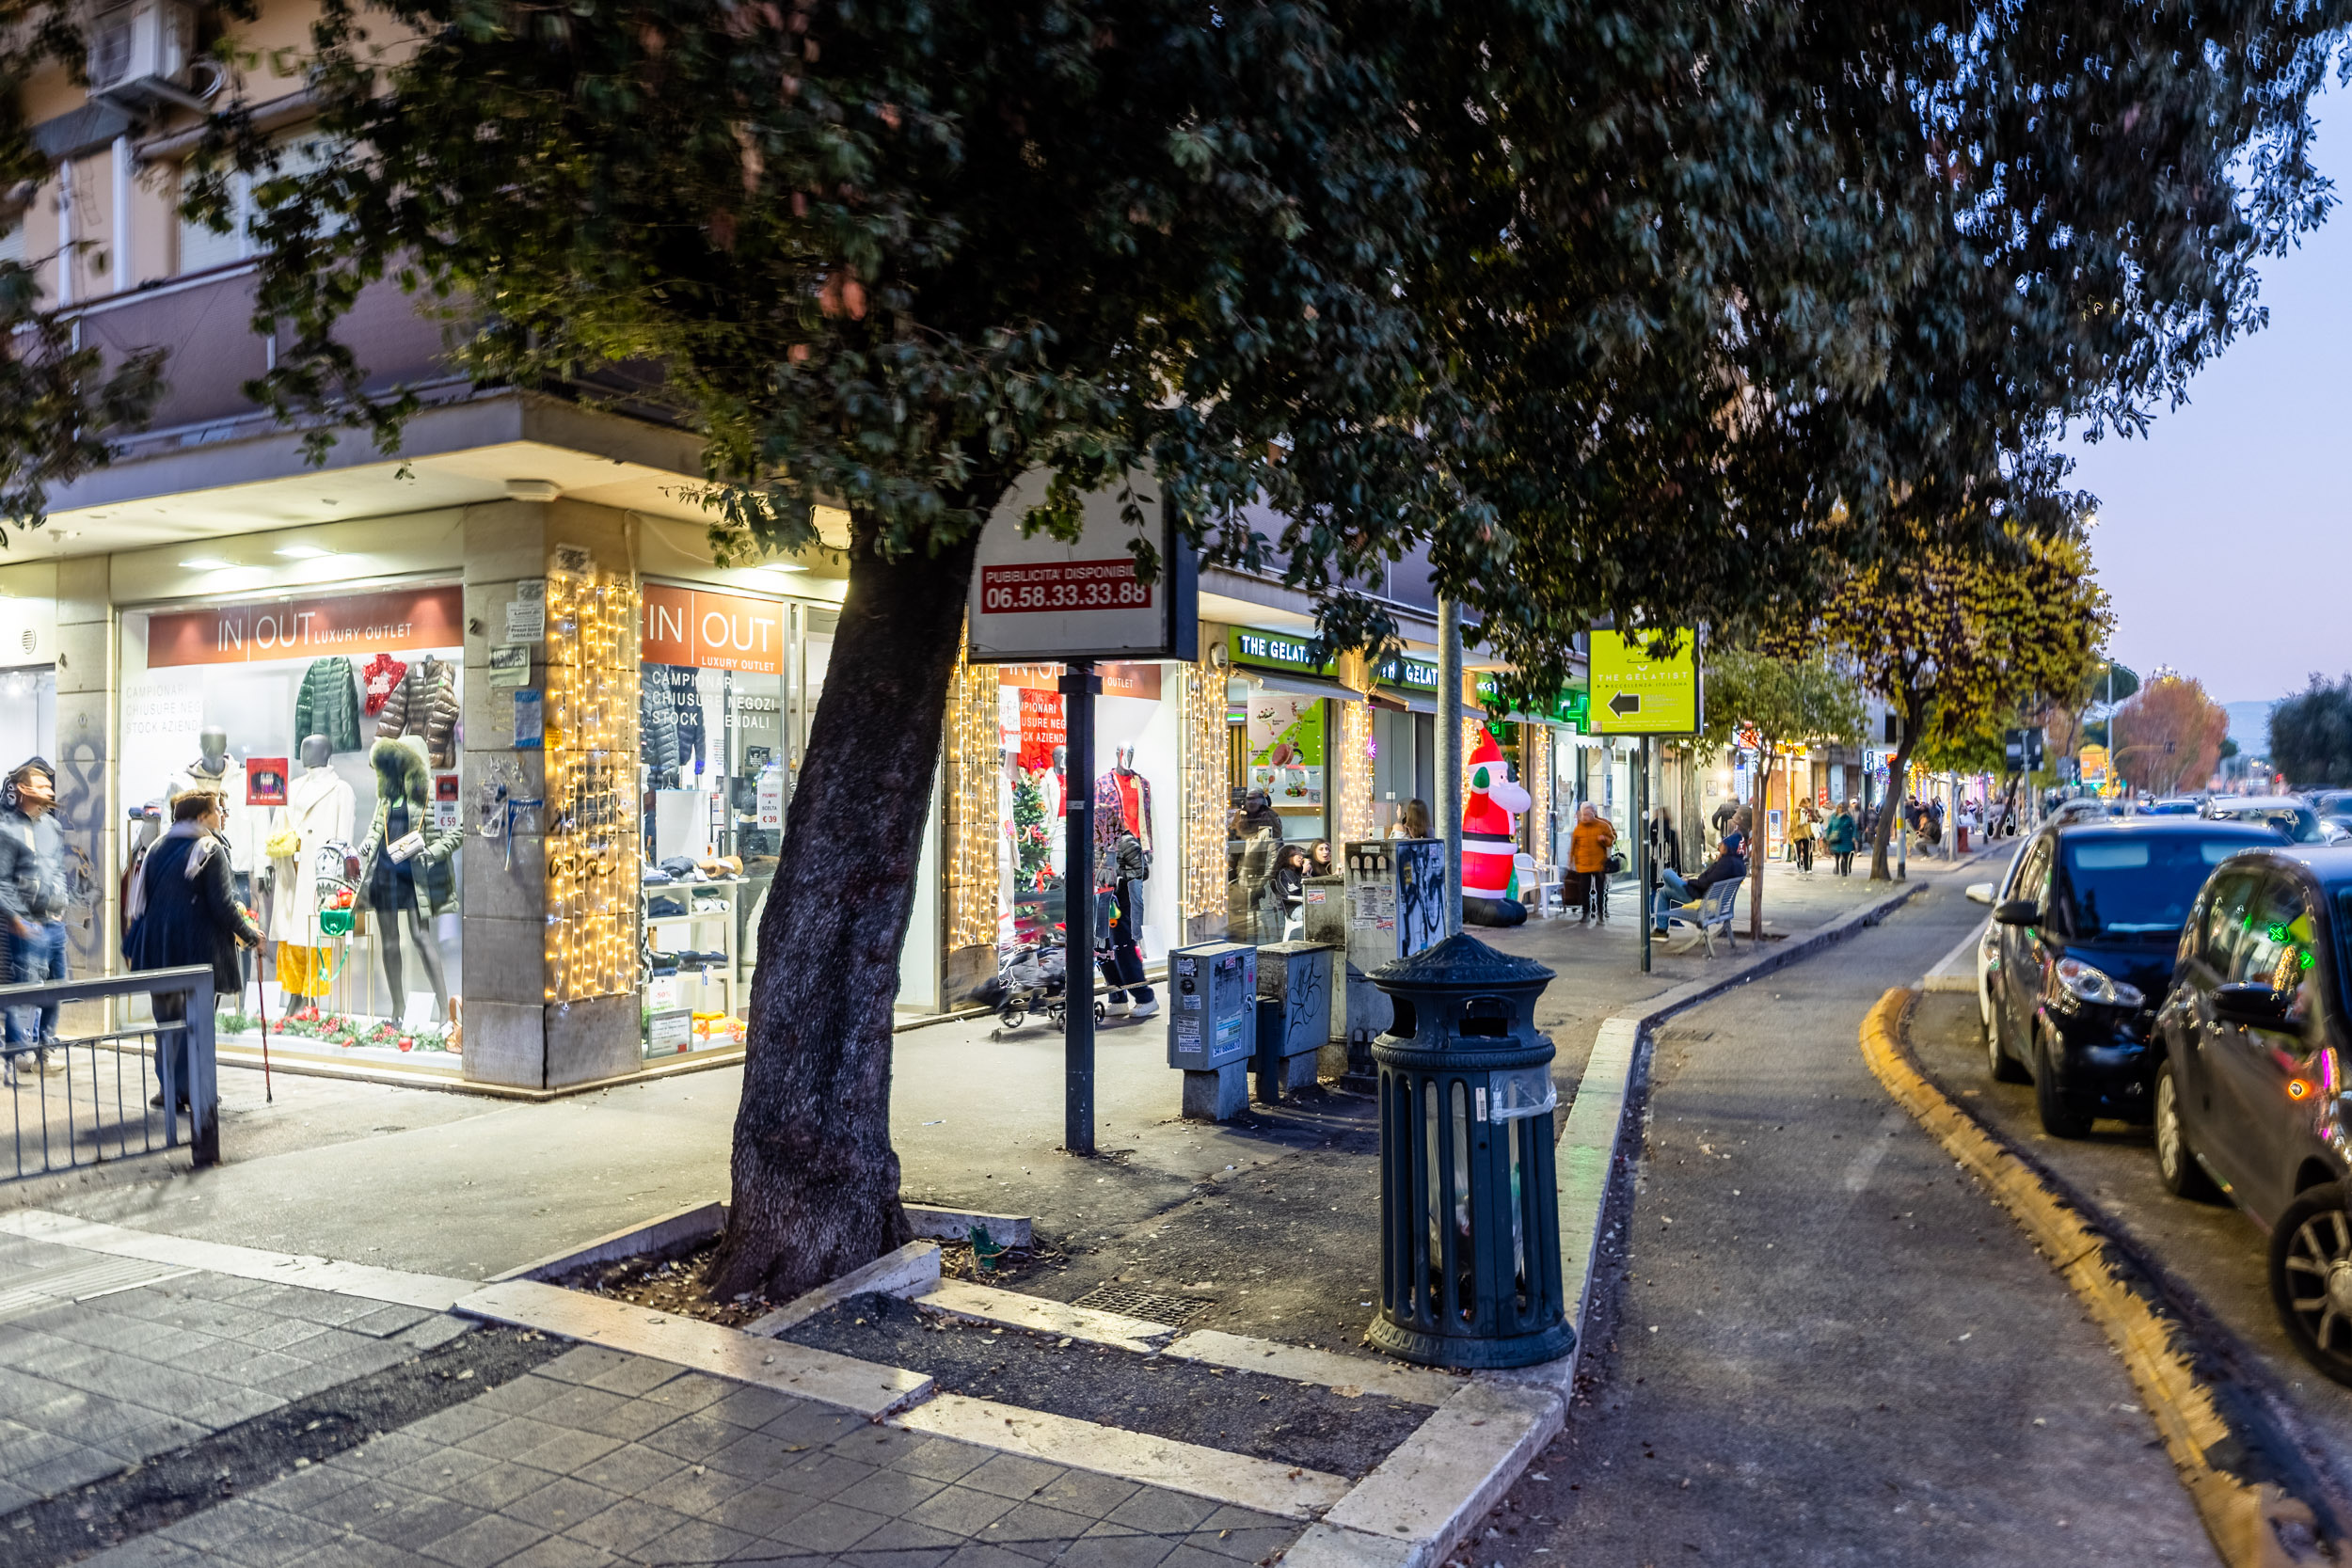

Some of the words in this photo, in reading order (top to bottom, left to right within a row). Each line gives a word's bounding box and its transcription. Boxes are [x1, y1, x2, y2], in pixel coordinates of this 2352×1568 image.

[986, 568, 1062, 583] PUBBLICITA'
[1065, 564, 1136, 580] DISPONIBIL
[986, 581, 1146, 610] 06.58.33.33.88
[217, 617, 242, 652] IN
[256, 611, 316, 649] OUT
[314, 627, 360, 644] LUXURY
[365, 623, 412, 641] OUTLET
[649, 603, 683, 643] IN
[702, 611, 775, 652] OUT
[1241, 635, 1266, 657] THE
[1270, 641, 1317, 665] GELAT
[701, 655, 738, 668] LUXURY
[740, 659, 775, 672] OUTLET
[652, 671, 737, 689] CAMPIONARI
[1106, 676, 1134, 689] OUTLET
[1406, 664, 1438, 686] GELAT
[1597, 673, 1619, 682] THE
[1626, 671, 1688, 681] GELATIST
[652, 691, 723, 708] CHIUSURE
[728, 696, 775, 711] NEGOZI
[126, 721, 158, 735] STOCK
[652, 710, 698, 725] STOCK
[724, 714, 770, 729] ENDALI
[447, 816, 456, 827] 59
